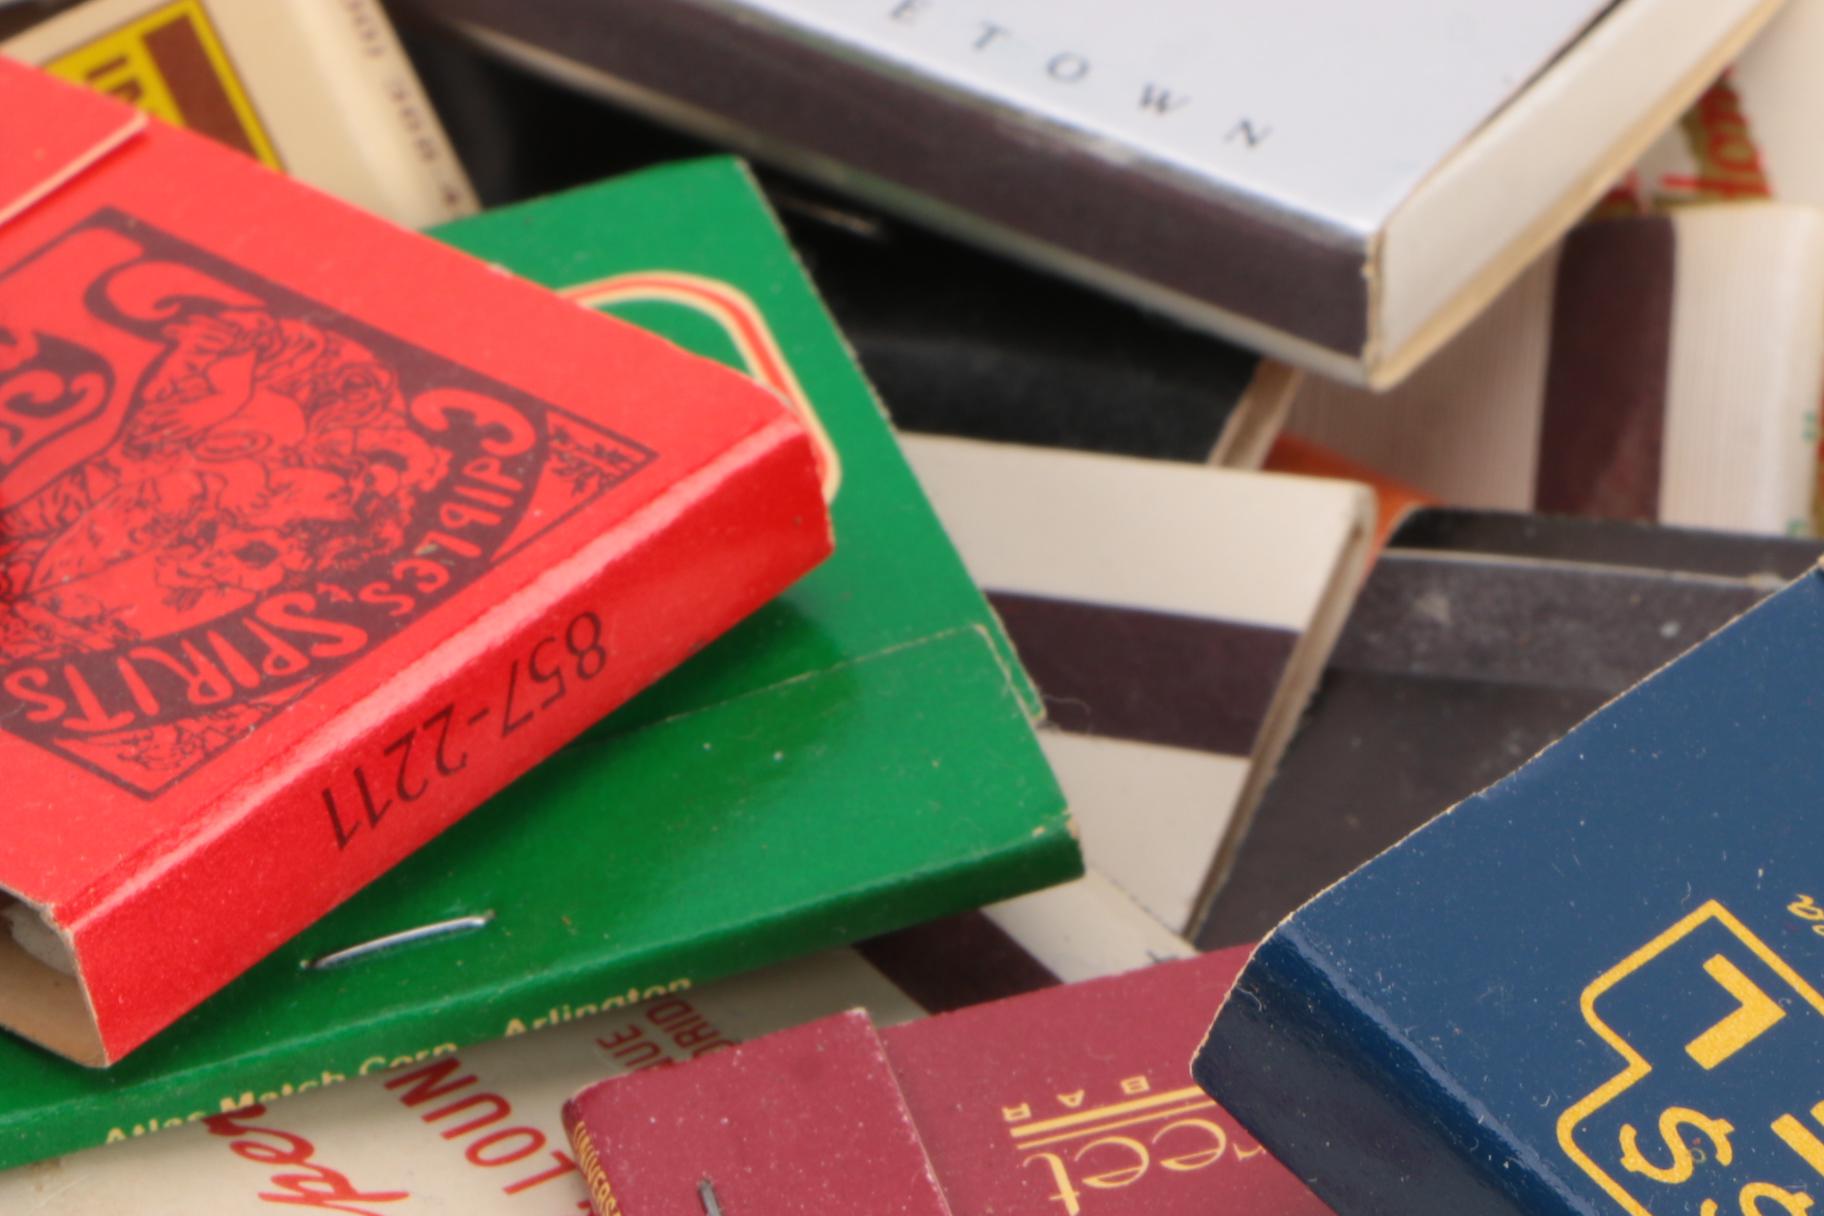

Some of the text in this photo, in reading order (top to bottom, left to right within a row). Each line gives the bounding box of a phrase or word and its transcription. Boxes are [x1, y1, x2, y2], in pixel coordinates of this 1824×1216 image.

[4, 592, 368, 729] SPIRITS
[320, 610, 608, 851] 857-2211
[1002, 1076, 1150, 1121] BAR
